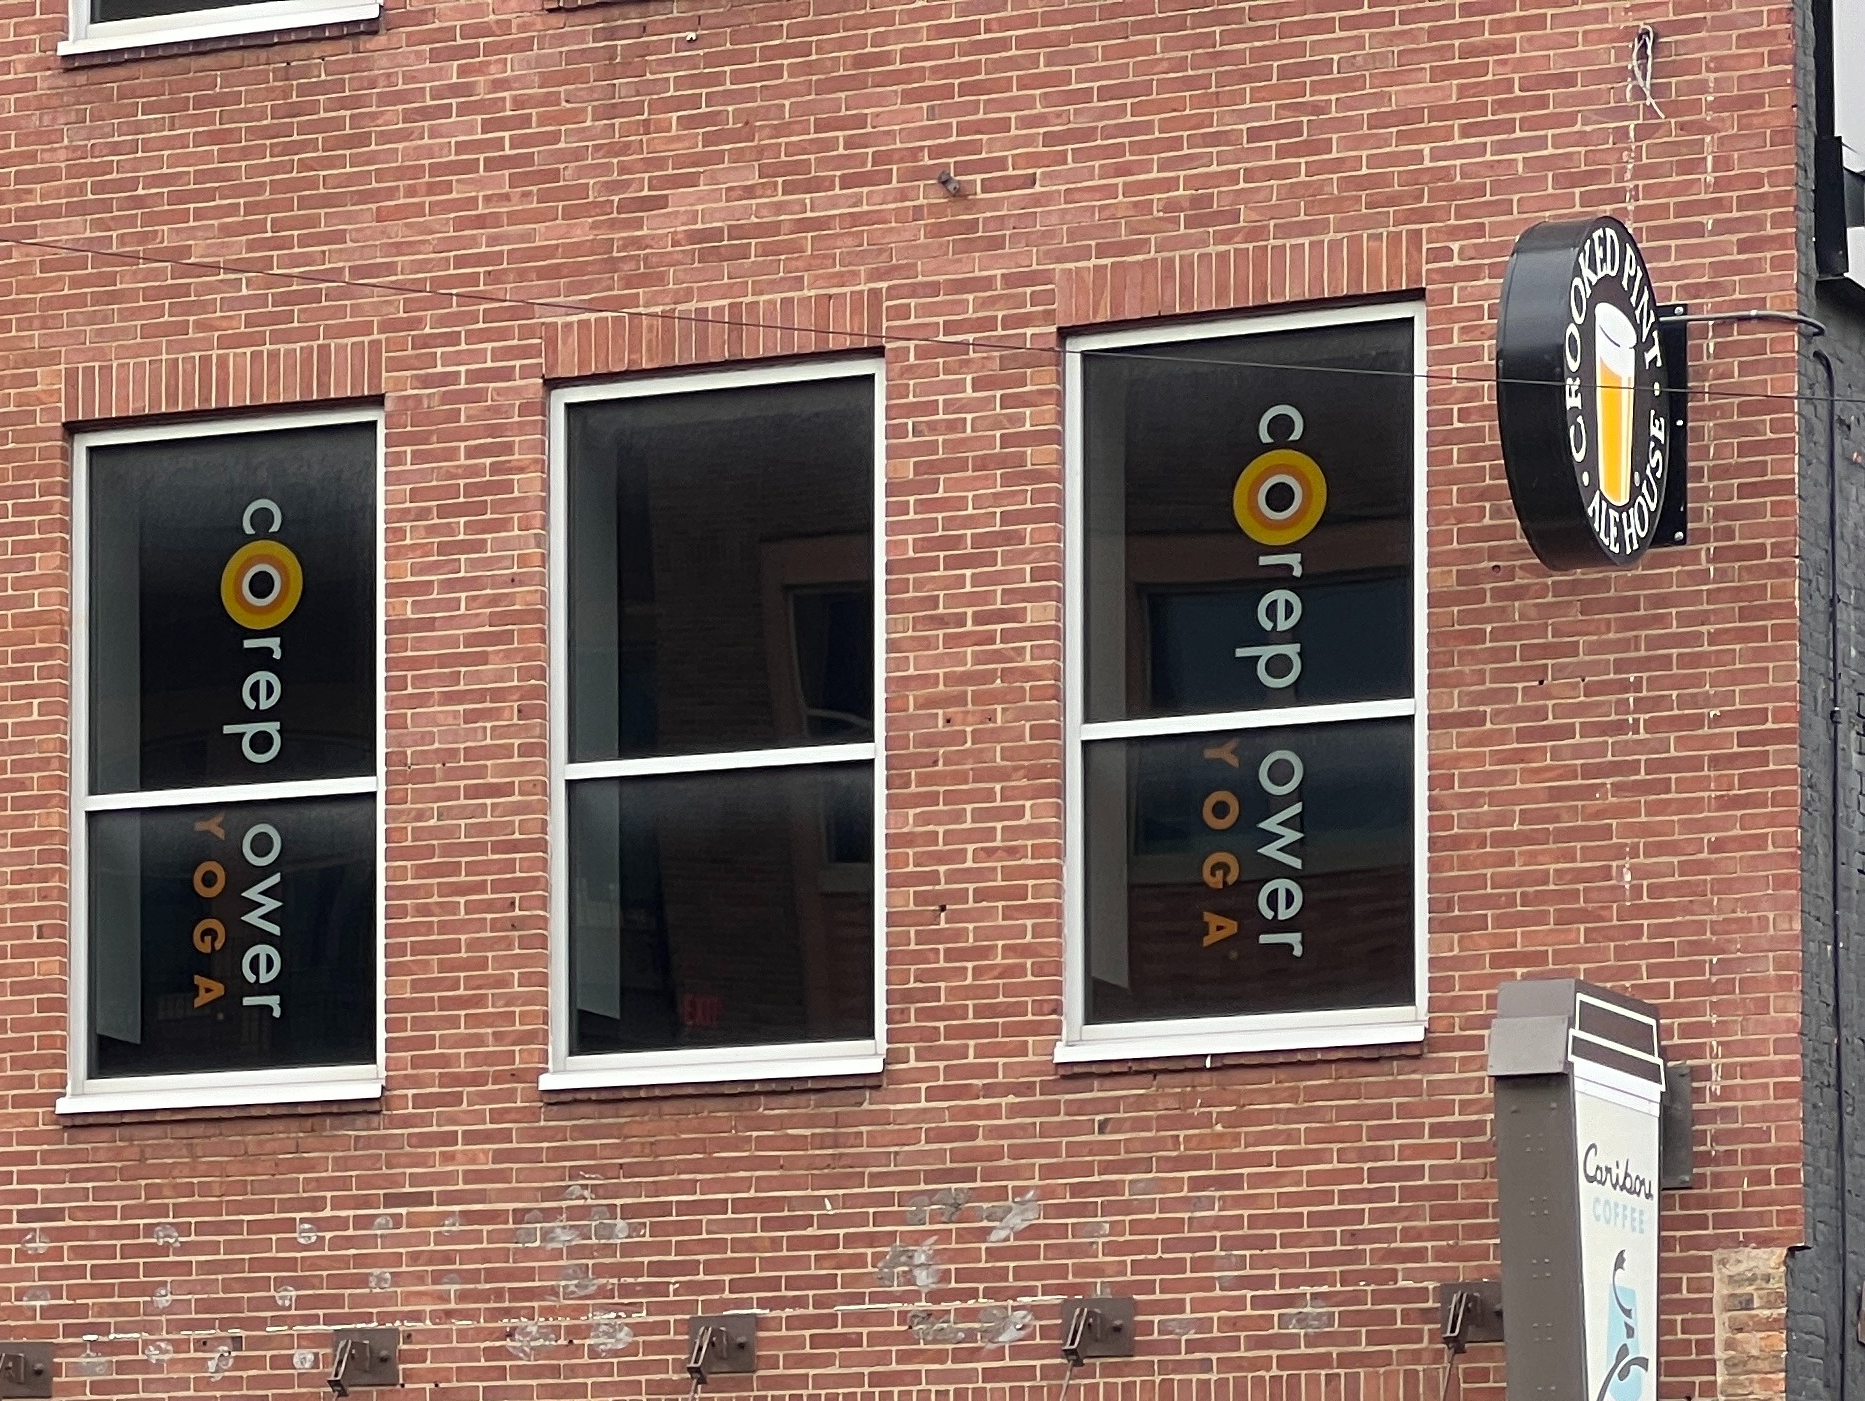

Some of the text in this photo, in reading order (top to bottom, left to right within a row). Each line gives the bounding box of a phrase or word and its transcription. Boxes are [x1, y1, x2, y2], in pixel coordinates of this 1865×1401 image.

[1565, 227, 1662, 463] CROOKED PINT
[193, 811, 226, 1009] YOGA
[1202, 739, 1240, 948] YOGA
[1583, 1143, 1654, 1201] Caribou
[1593, 1197, 1645, 1234] COFFEE
